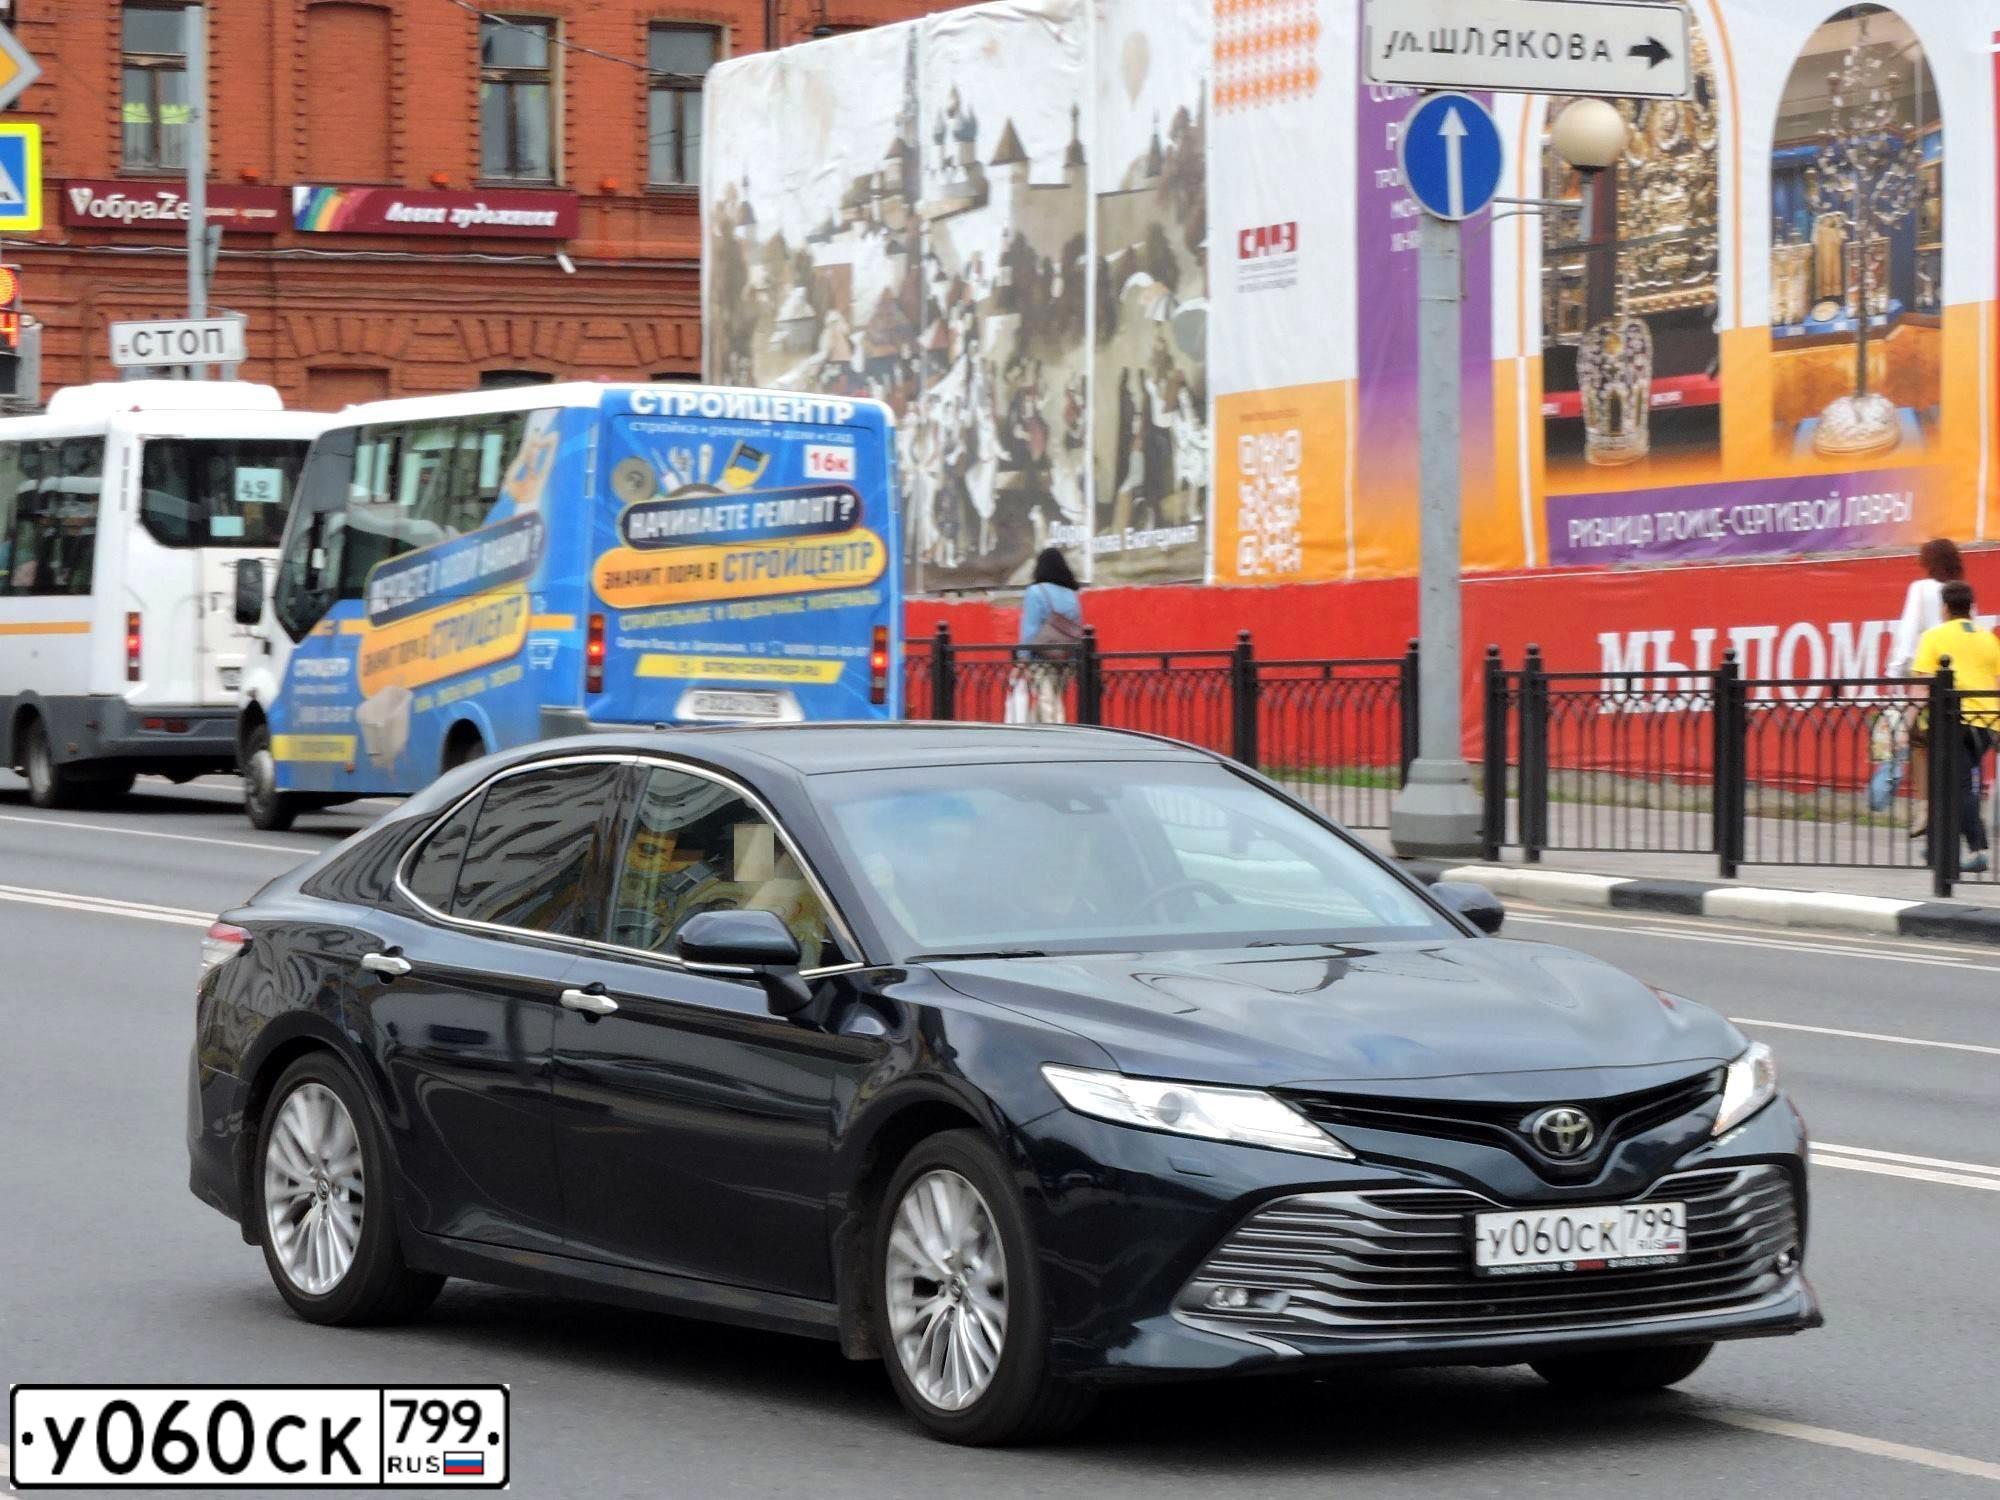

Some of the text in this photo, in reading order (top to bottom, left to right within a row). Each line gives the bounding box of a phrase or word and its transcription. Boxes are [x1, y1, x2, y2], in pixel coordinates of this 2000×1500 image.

[131, 328, 225, 358] СТОП
[629, 388, 855, 426] СТРОЙЦЕНТР
[628, 503, 749, 540] НАЧИНАЕТЕ
[722, 541, 875, 583] СТРОЙЦЕНТР
[1624, 1207, 1675, 1240] 799
